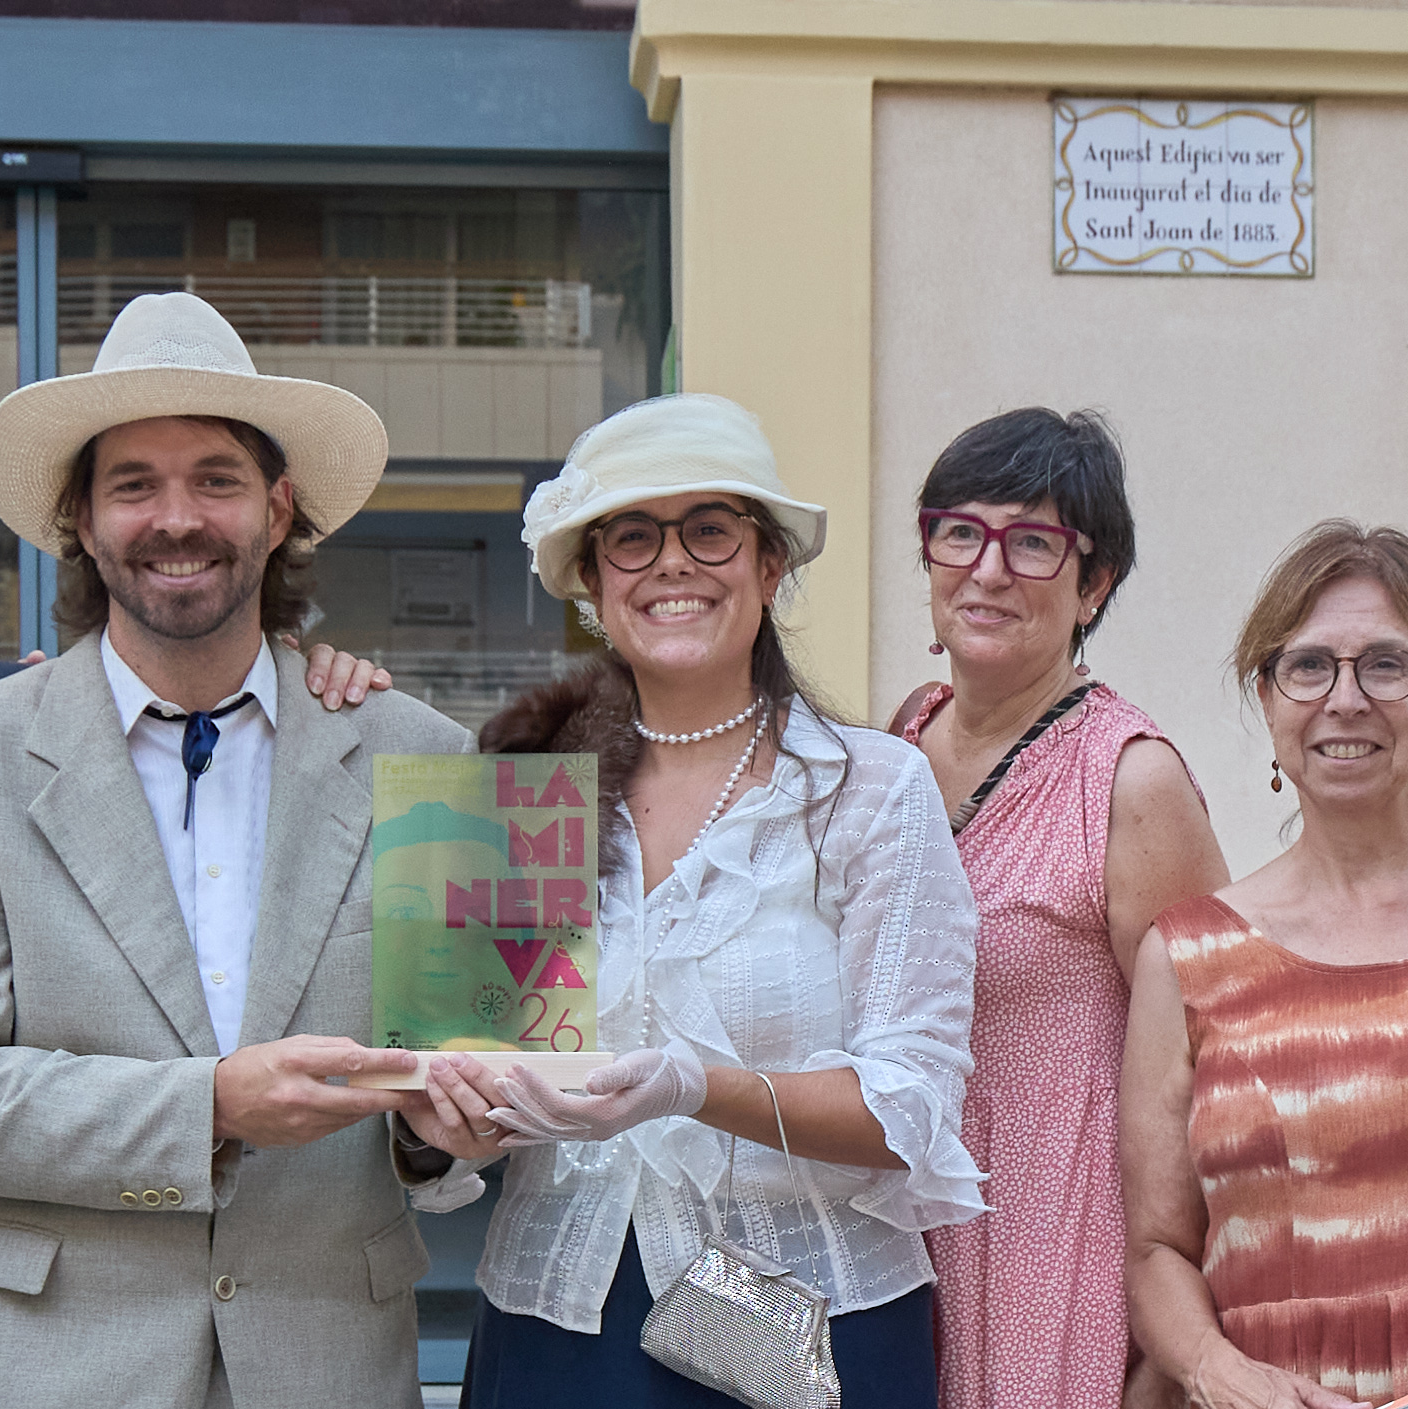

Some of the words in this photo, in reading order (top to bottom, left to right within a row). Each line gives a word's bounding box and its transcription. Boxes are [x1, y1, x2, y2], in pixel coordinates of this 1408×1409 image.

[1084, 139, 1152, 171] Aquest
[1160, 139, 1223, 173] Edifici
[1227, 149, 1251, 164] va
[1255, 149, 1285, 165] ser
[1084, 178, 1187, 212] Inaugurat
[1194, 178, 1211, 202] el
[1220, 178, 1252, 202] dia
[1259, 180, 1282, 203] de
[1085, 215, 1134, 239] Sant
[1143, 218, 1193, 240] Joan
[1200, 217, 1223, 241] de
[496, 760, 588, 807] LA
[508, 816, 585, 867] MI
[445, 878, 593, 928] NER
[493, 939, 588, 989] VA
[518, 992, 583, 1052] 26
